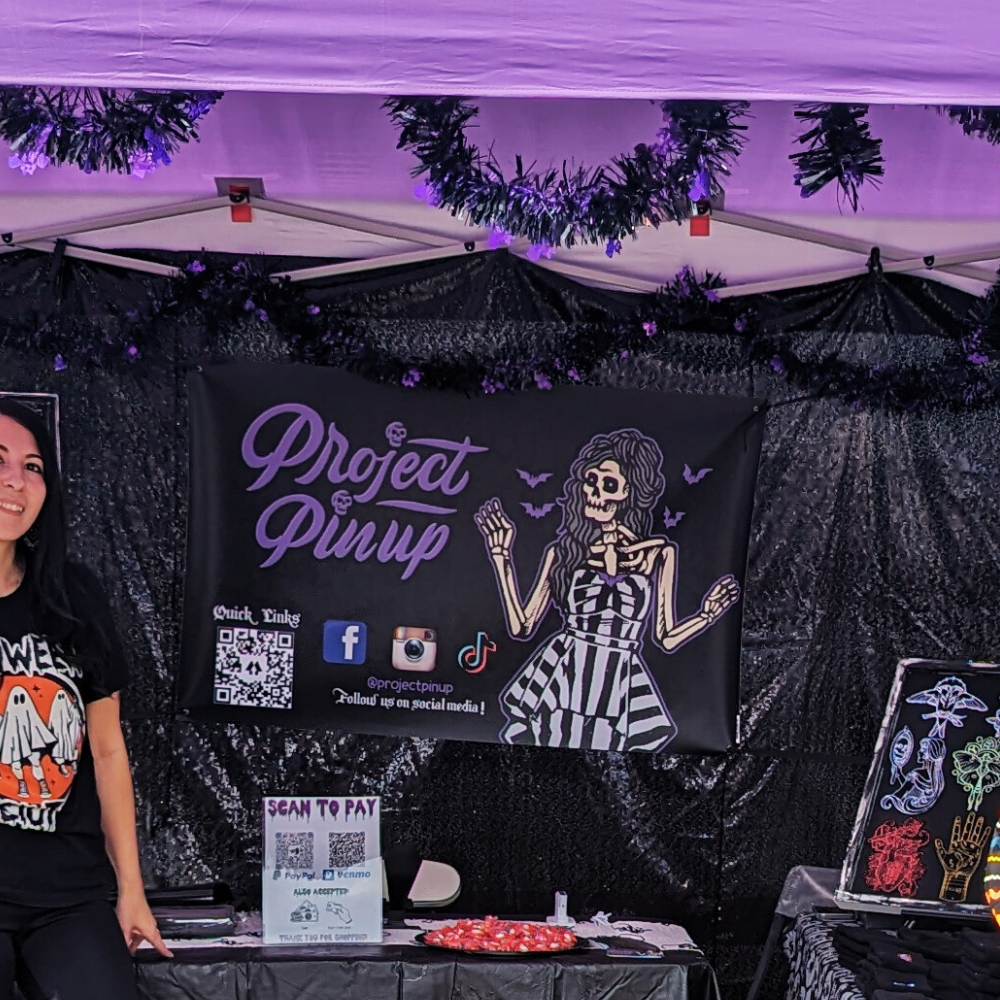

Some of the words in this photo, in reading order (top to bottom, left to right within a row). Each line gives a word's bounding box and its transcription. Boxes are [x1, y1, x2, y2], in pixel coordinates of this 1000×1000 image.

[242, 403, 489, 503] Project
[255, 490, 450, 581] Pinup
[213, 604, 259, 626] Quick
[261, 608, 301, 629] Links
[367, 676, 454, 694] @projectpinup
[332, 687, 377, 706] Follow
[380, 699, 395, 710] us
[396, 700, 410, 710] on
[411, 699, 446, 713] social
[268, 799, 311, 822] SCAN
[316, 799, 340, 821] TO
[345, 798, 377, 822] PAY
